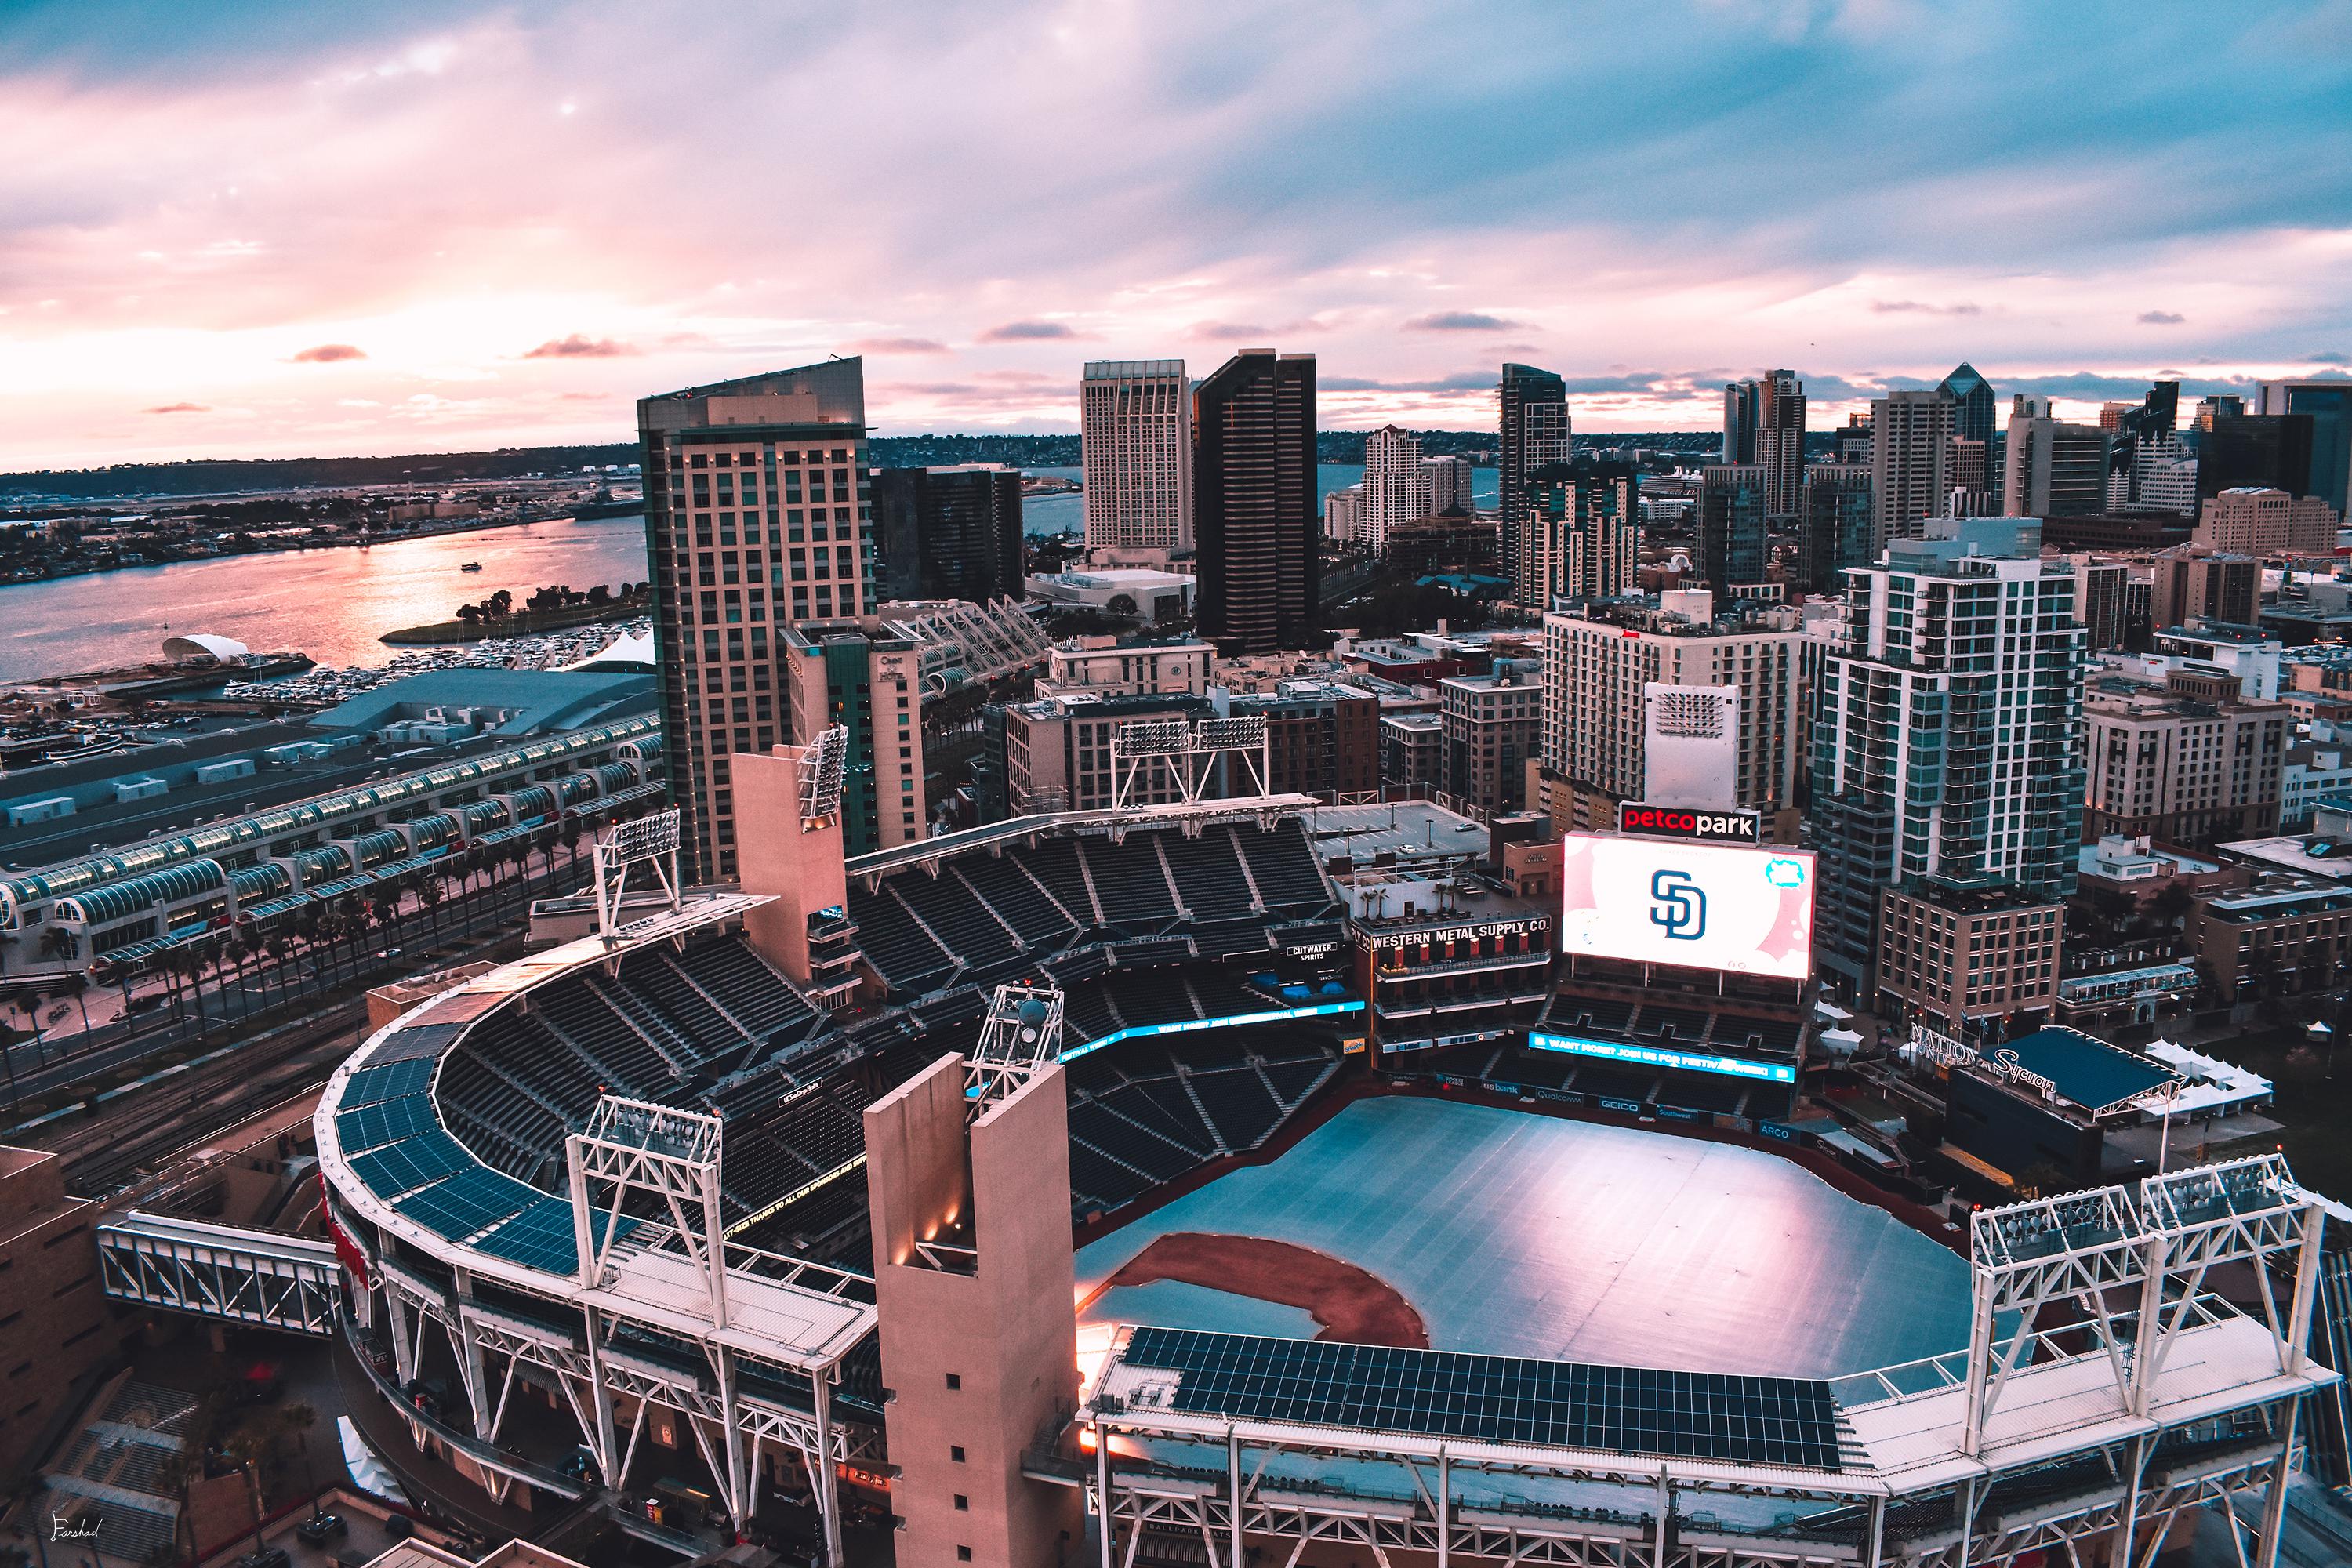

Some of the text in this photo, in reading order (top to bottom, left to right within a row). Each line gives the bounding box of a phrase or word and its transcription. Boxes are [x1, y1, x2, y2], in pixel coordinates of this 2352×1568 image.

[1650, 869, 1707, 940] SD
[1373, 920, 1550, 949] WESTERN METAL SUPPLY CO.
[1293, 943, 1332, 955] CUTWATER
[1993, 1049, 2056, 1093] Sycuan
[1601, 1100, 1639, 1112] GEICO
[1659, 1109, 1691, 1120] Southwest
[1761, 1126, 1789, 1138] ARCO
[775, 1202, 785, 1210] TO
[785, 1194, 797, 1206] ALL
[1149, 1523, 1199, 1535] BALLPARK
